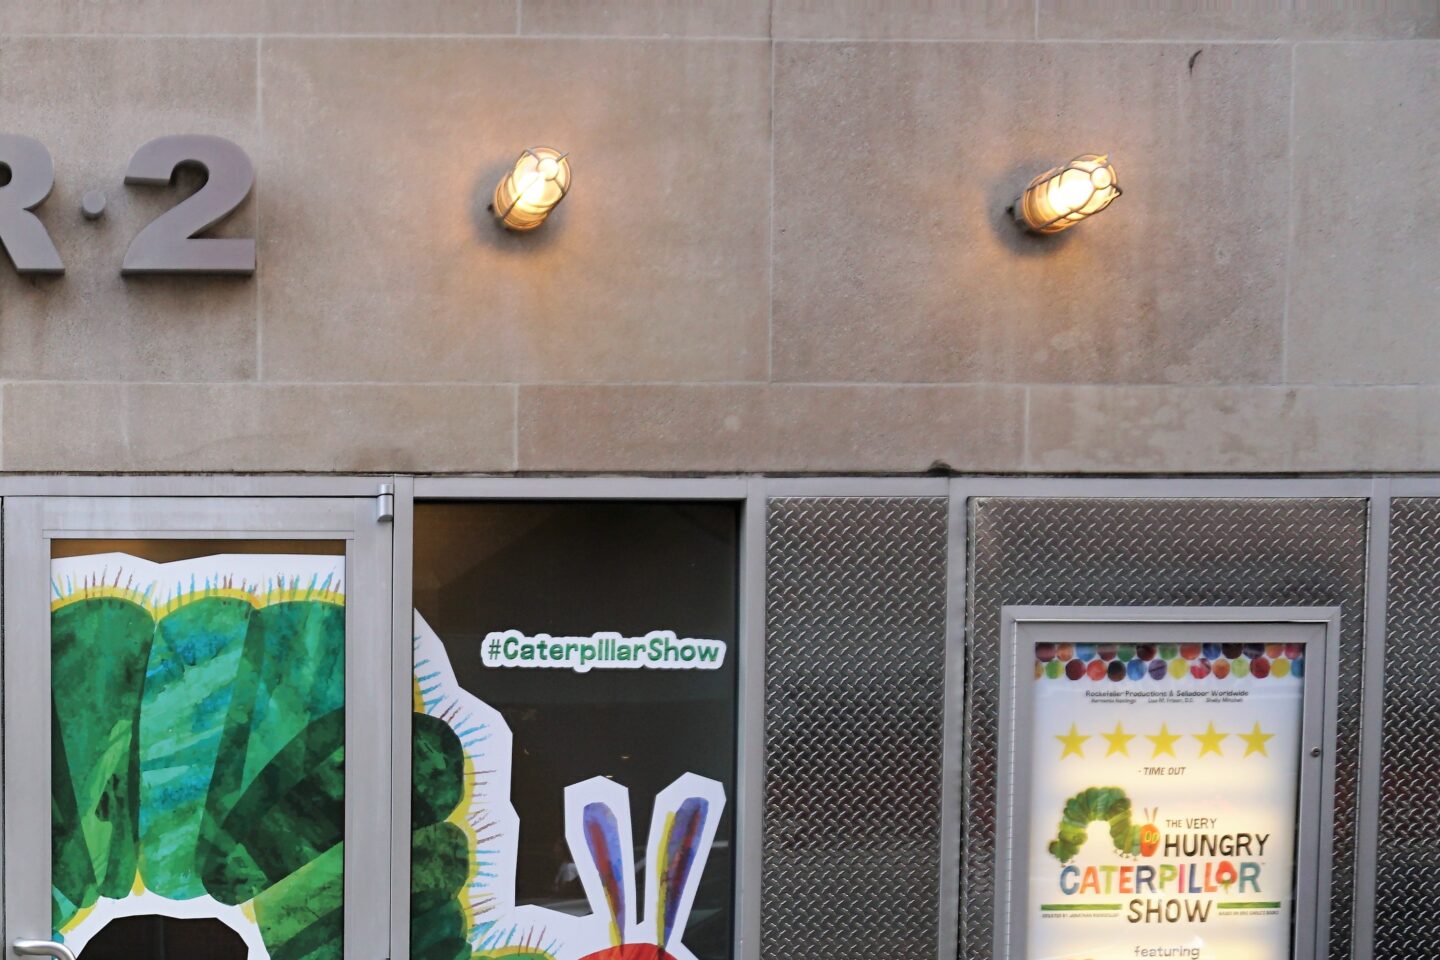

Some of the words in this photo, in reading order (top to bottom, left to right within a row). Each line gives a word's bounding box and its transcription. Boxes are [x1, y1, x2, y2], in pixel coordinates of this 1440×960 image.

[488, 636, 719, 665] #CaterpillarShow
[1168, 767, 1186, 776] OUT
[1165, 819, 1182, 829] THE
[1185, 818, 1217, 830] VERY
[1164, 833, 1270, 857] HUNGRY
[1127, 899, 1213, 923] SHOW
[1134, 946, 1200, 959] featuring
